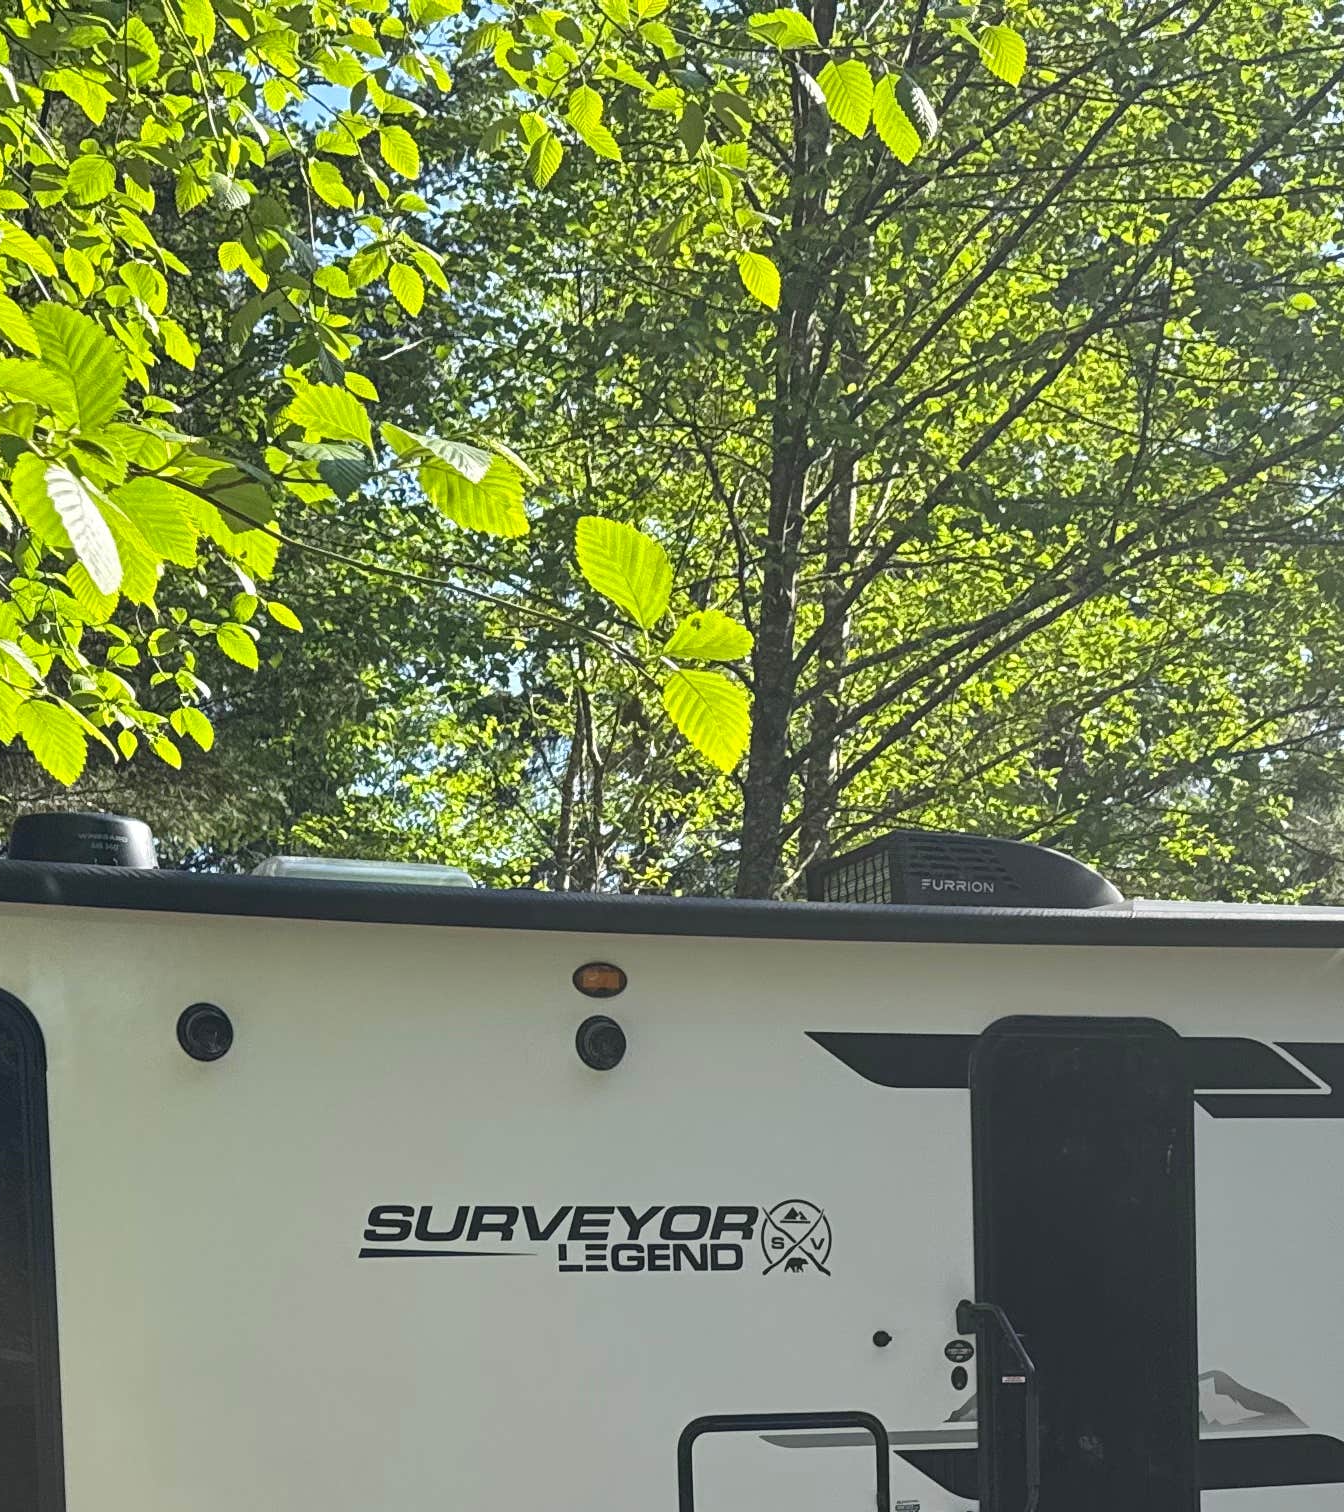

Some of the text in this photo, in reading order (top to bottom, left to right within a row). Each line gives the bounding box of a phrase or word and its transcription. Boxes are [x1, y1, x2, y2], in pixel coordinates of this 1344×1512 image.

[921, 878, 995, 894] FURRION
[362, 1205, 760, 1242] SURVEYOR
[771, 1236, 785, 1250] S
[809, 1237, 825, 1250] V
[558, 1243, 745, 1273] LEGEND
